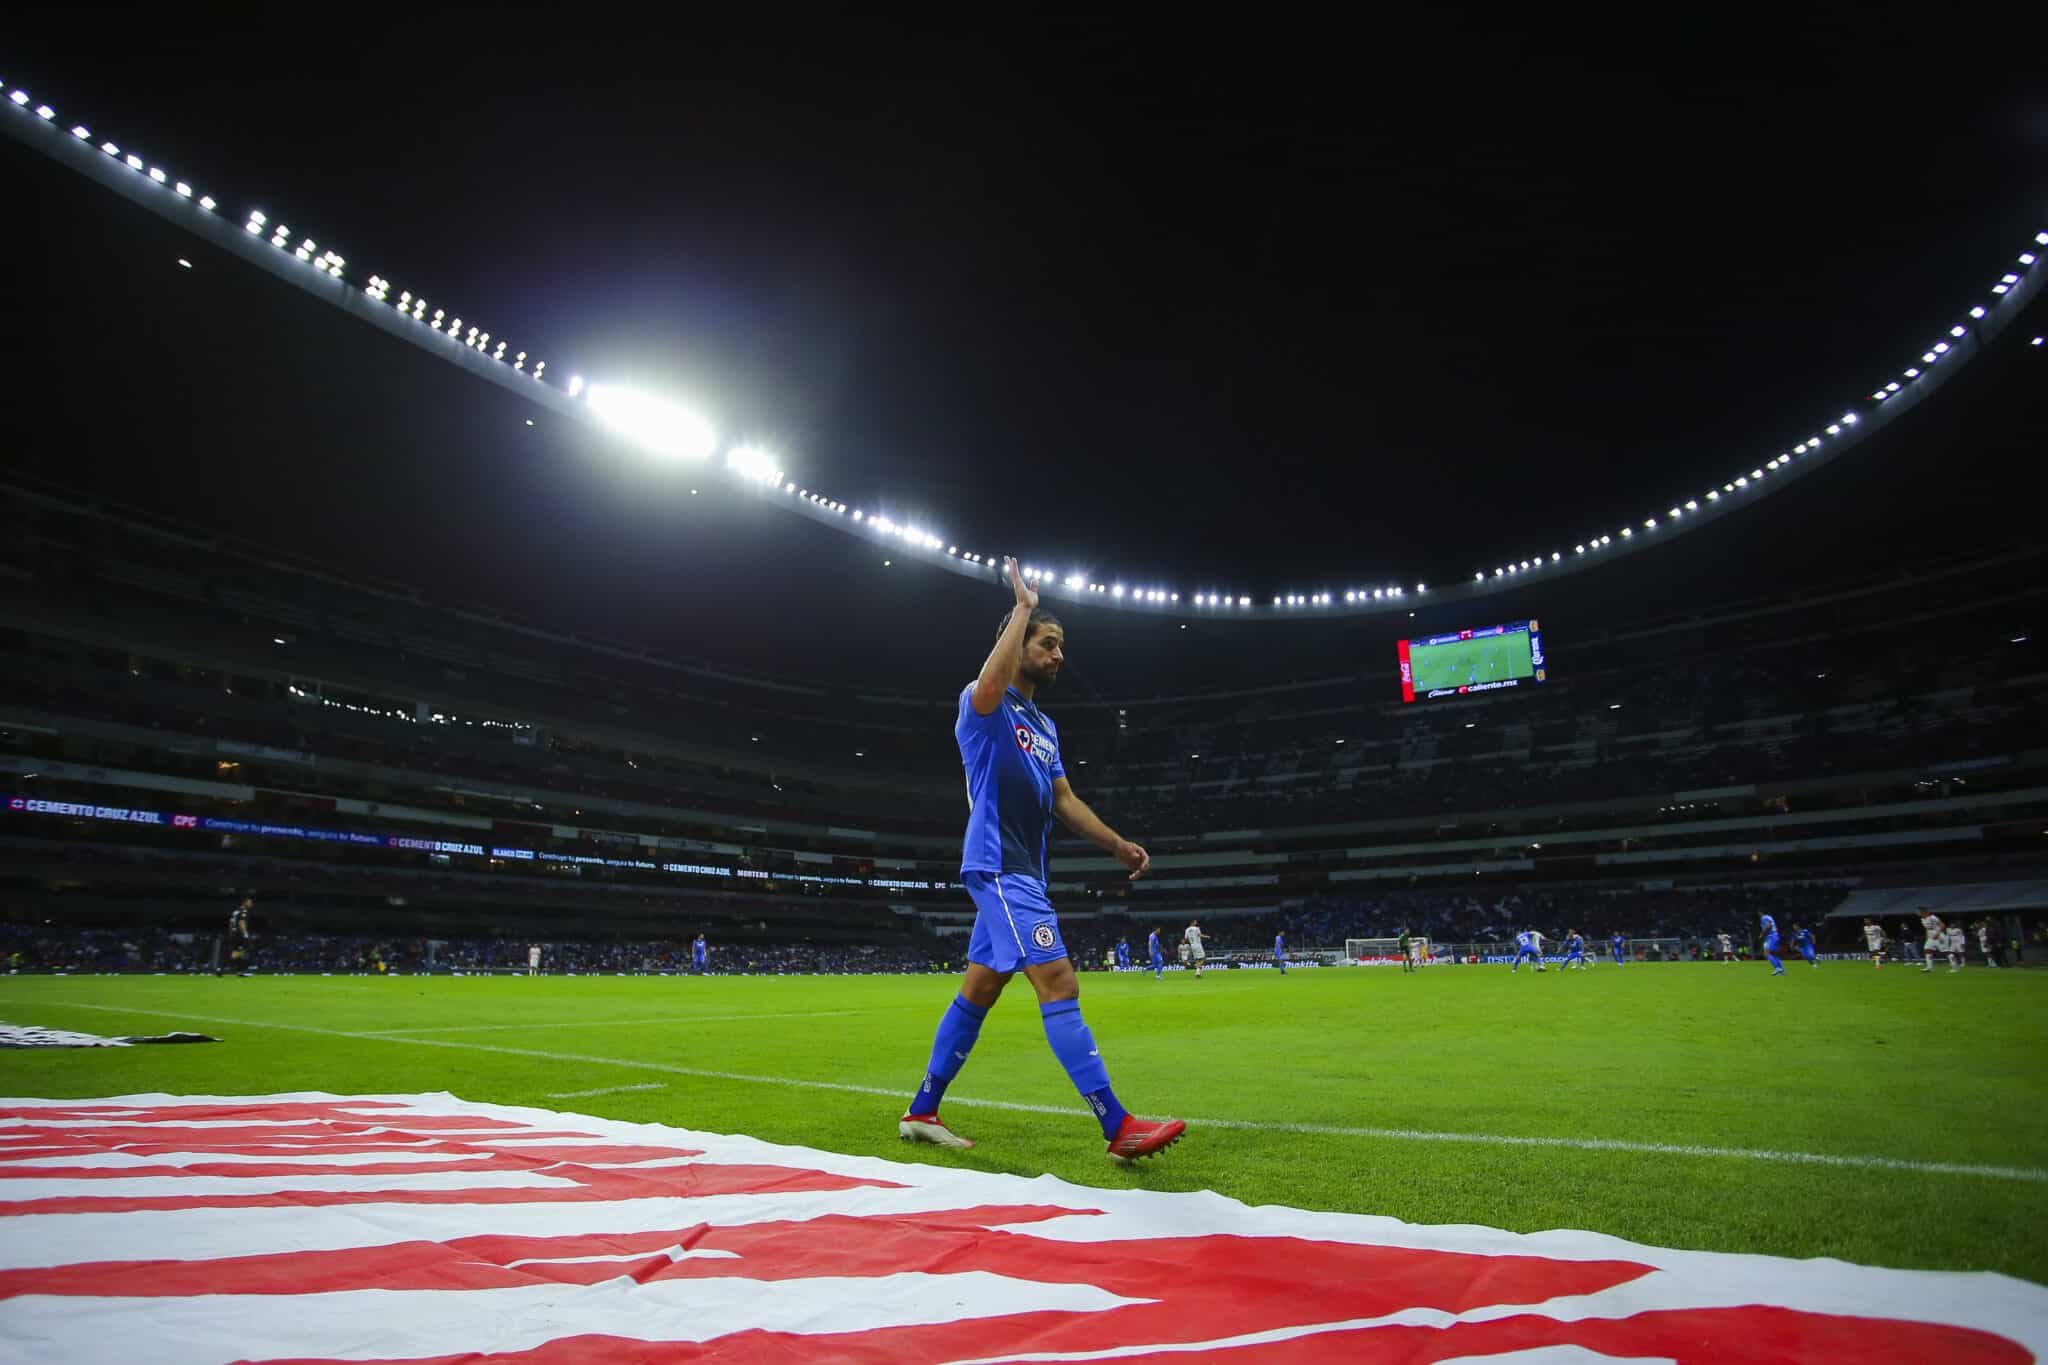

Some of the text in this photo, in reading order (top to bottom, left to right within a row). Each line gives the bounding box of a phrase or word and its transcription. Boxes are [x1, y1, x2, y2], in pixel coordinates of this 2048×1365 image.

[1467, 680, 1518, 692] caliente.mx
[26, 799, 93, 817] CEMENTO
[95, 807, 129, 821] CRUZ
[174, 815, 197, 828] CPC
[398, 838, 441, 851] CEMENTO
[442, 842, 463, 853] CRUZ
[669, 864, 699, 874] CEMENTO
[873, 880, 899, 888] CEMENTO
[1239, 961, 1274, 970] makita
